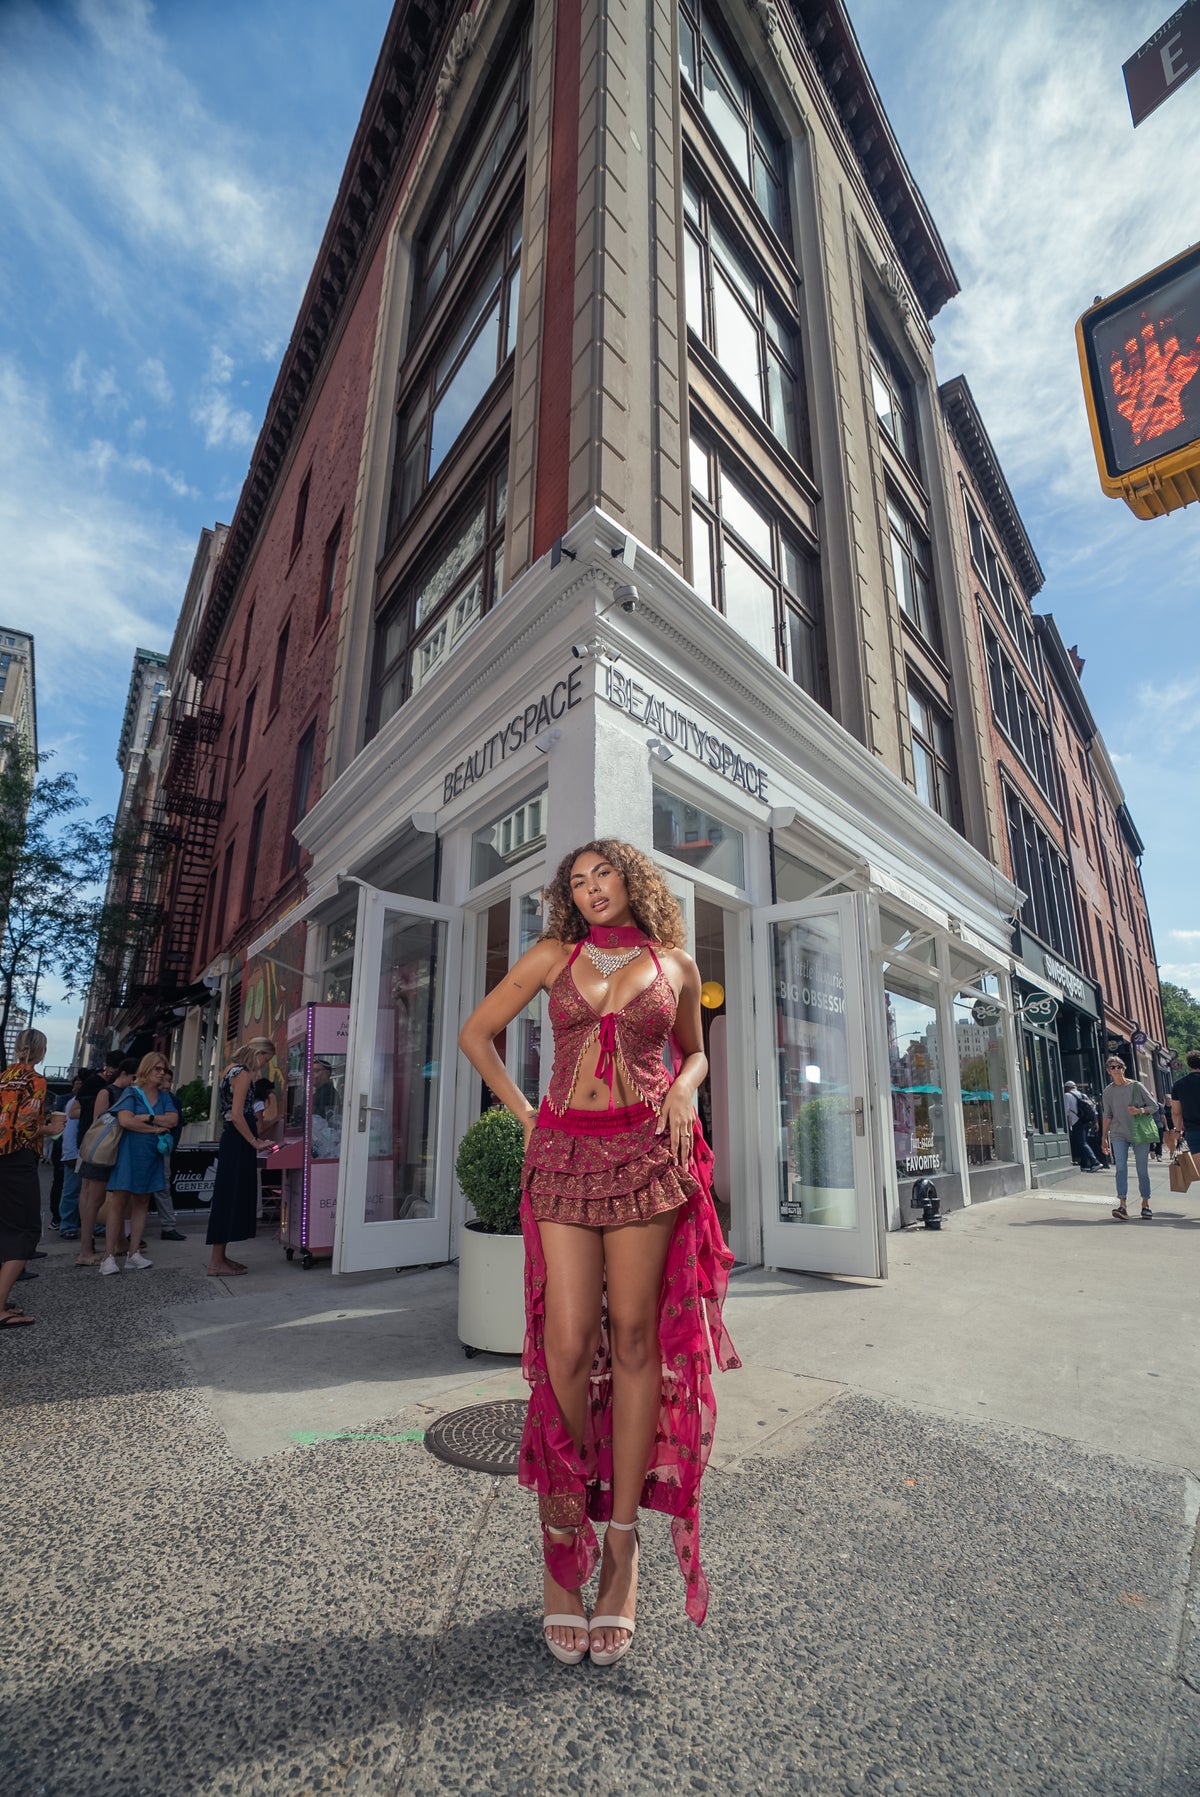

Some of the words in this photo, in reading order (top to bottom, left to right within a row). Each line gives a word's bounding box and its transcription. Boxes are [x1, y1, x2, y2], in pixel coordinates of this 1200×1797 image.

[1160, 31, 1188, 86] E
[443, 664, 582, 804] BEAUTYSPACE
[607, 664, 769, 802] BEAUTYSPACE
[794, 955, 814, 979] little
[780, 980, 799, 1002] BIG
[1029, 1001, 1051, 1015] sg
[906, 1154, 940, 1172] FAVORITES
[172, 1169, 203, 1184] juice
